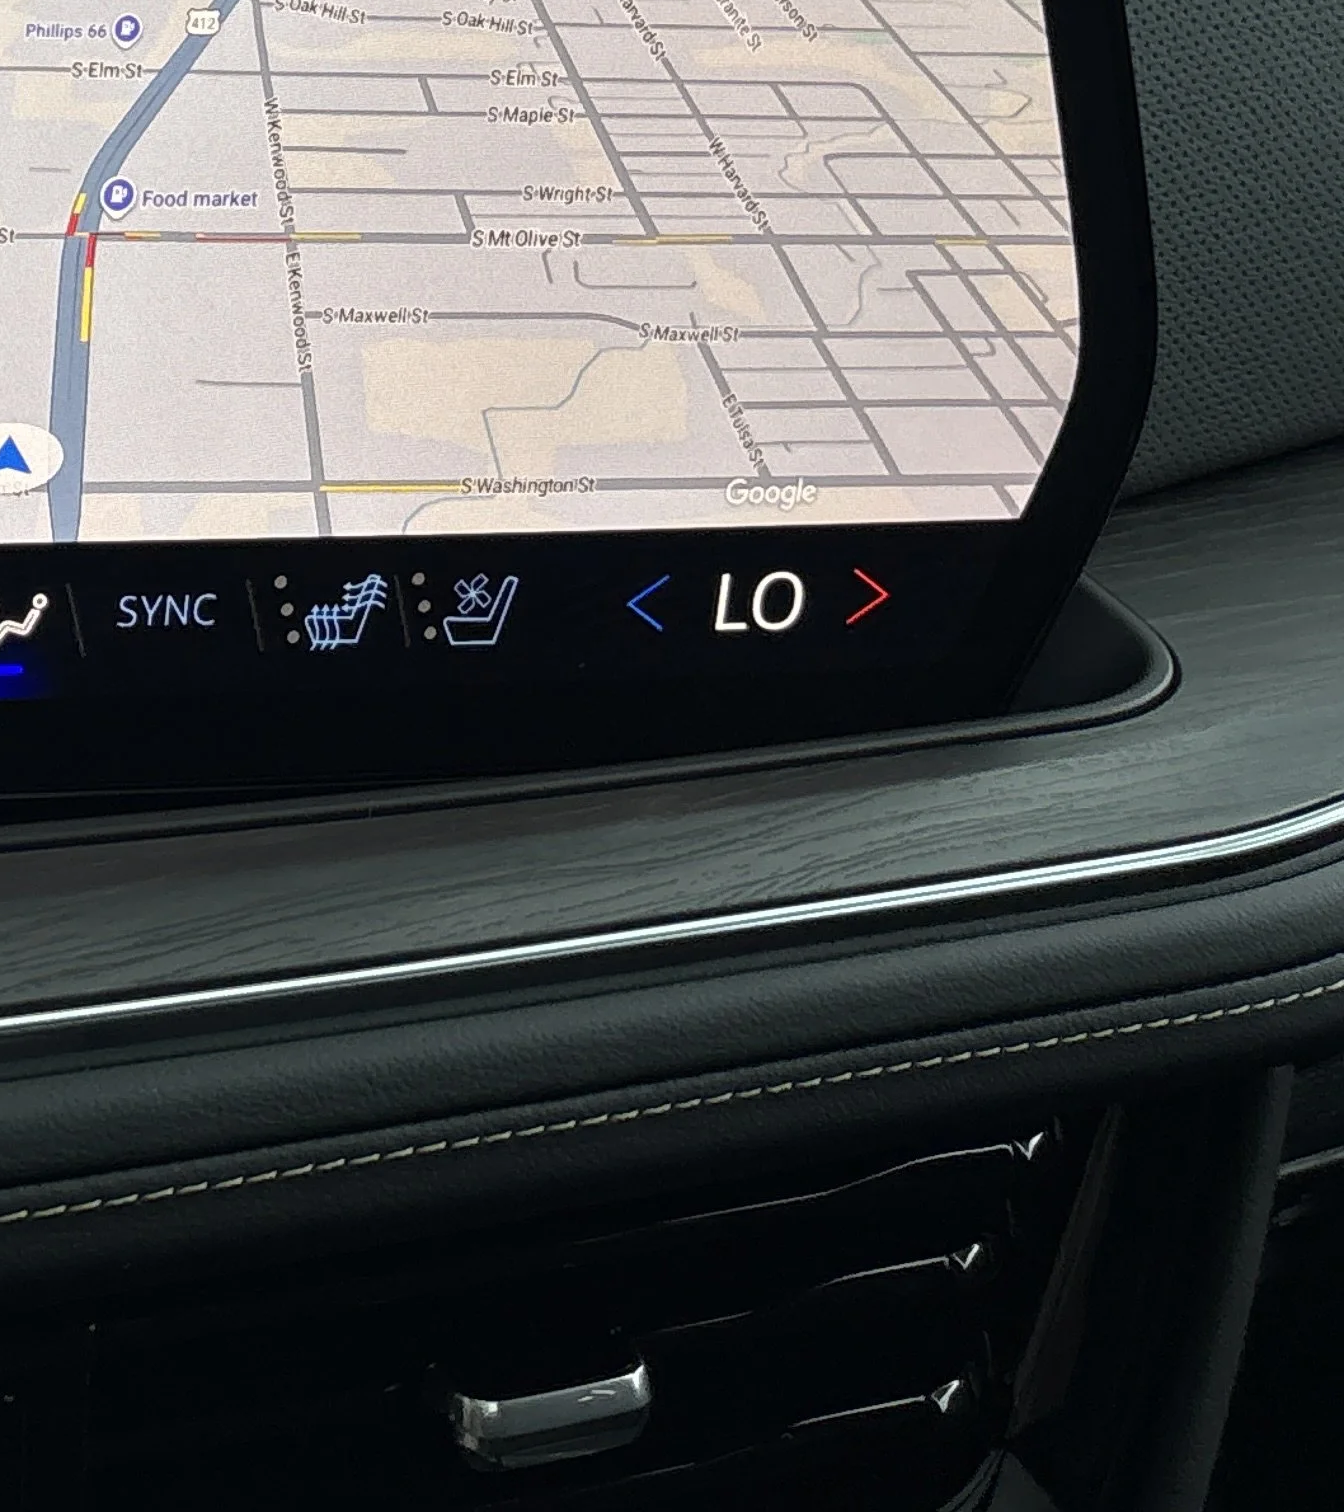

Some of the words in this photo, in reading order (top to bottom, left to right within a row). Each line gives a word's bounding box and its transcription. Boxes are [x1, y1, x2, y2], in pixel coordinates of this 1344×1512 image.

[25, 24, 83, 40] Phillips
[88, 24, 108, 39] 66
[191, 17, 216, 30] 412
[747, 33, 762, 53] St
[72, 63, 81, 78] S
[88, 63, 119, 78] Elm
[124, 63, 142, 79] St
[490, 70, 500, 85] S
[506, 70, 536, 85] Elm
[541, 71, 559, 86] St
[488, 108, 498, 123] S
[503, 108, 553, 125] Maple
[558, 108, 575, 123] St
[142, 190, 188, 207] Food
[194, 191, 258, 207] market
[523, 187, 533, 201] S
[538, 186, 590, 204] Wright
[595, 187, 613, 202] St
[472, 231, 484, 247] S
[488, 231, 511, 247] Mt
[515, 231, 558, 247] Olive
[563, 232, 581, 248] St
[323, 308, 334, 323] S
[339, 308, 406, 323] Maxwell
[412, 308, 429, 324] St
[638, 322, 650, 338] S
[654, 324, 719, 342] Maxwell
[723, 327, 740, 342] St
[461, 477, 472, 494] S
[476, 477, 572, 497] Washington
[577, 477, 595, 494] St
[725, 478, 816, 510] Google
[713, 570, 804, 633] LO
[116, 593, 218, 628] SYNC
